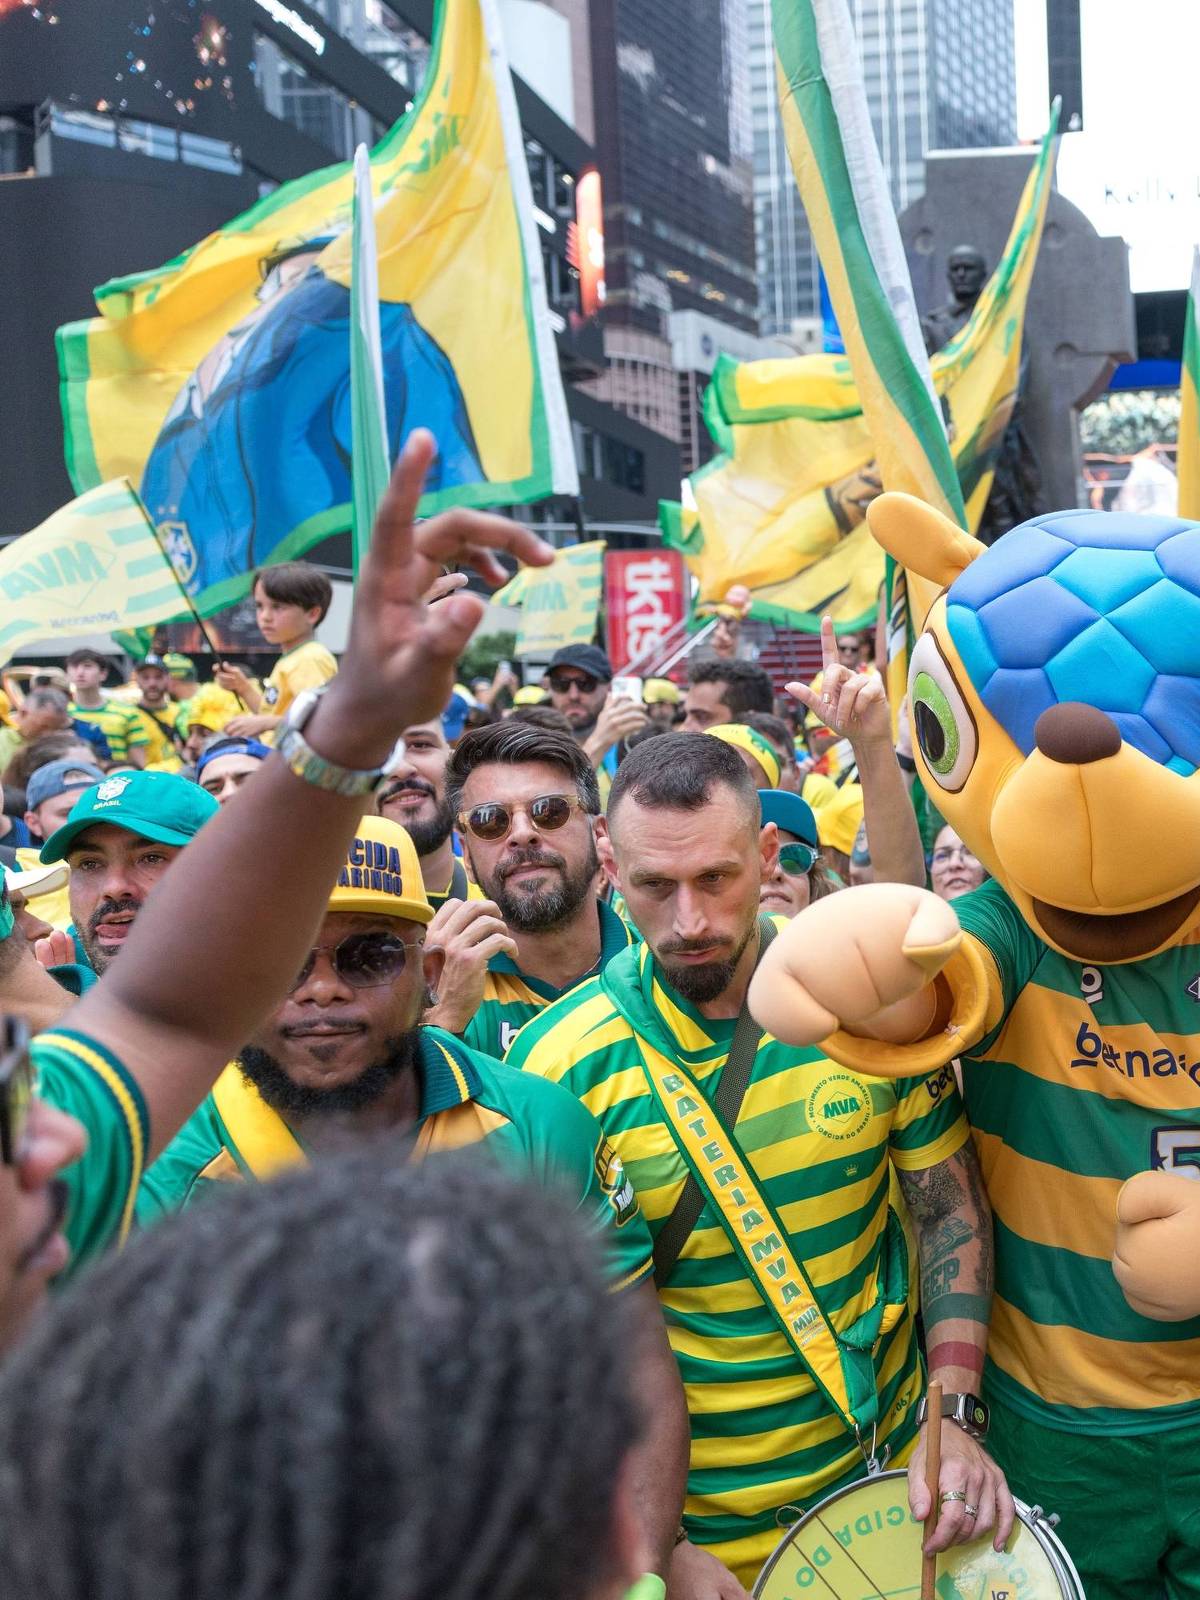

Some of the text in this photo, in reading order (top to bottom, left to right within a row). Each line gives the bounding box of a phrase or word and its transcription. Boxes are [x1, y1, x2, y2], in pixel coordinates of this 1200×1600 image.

[625, 558, 674, 663] tkts
[93, 799, 121, 811] BRASIL
[808, 1074, 871, 1119] MOVIMENTO VERDE AMARELO
[823, 1096, 861, 1119] MVA
[816, 1112, 871, 1140] TORCIDA DO BRASIL
